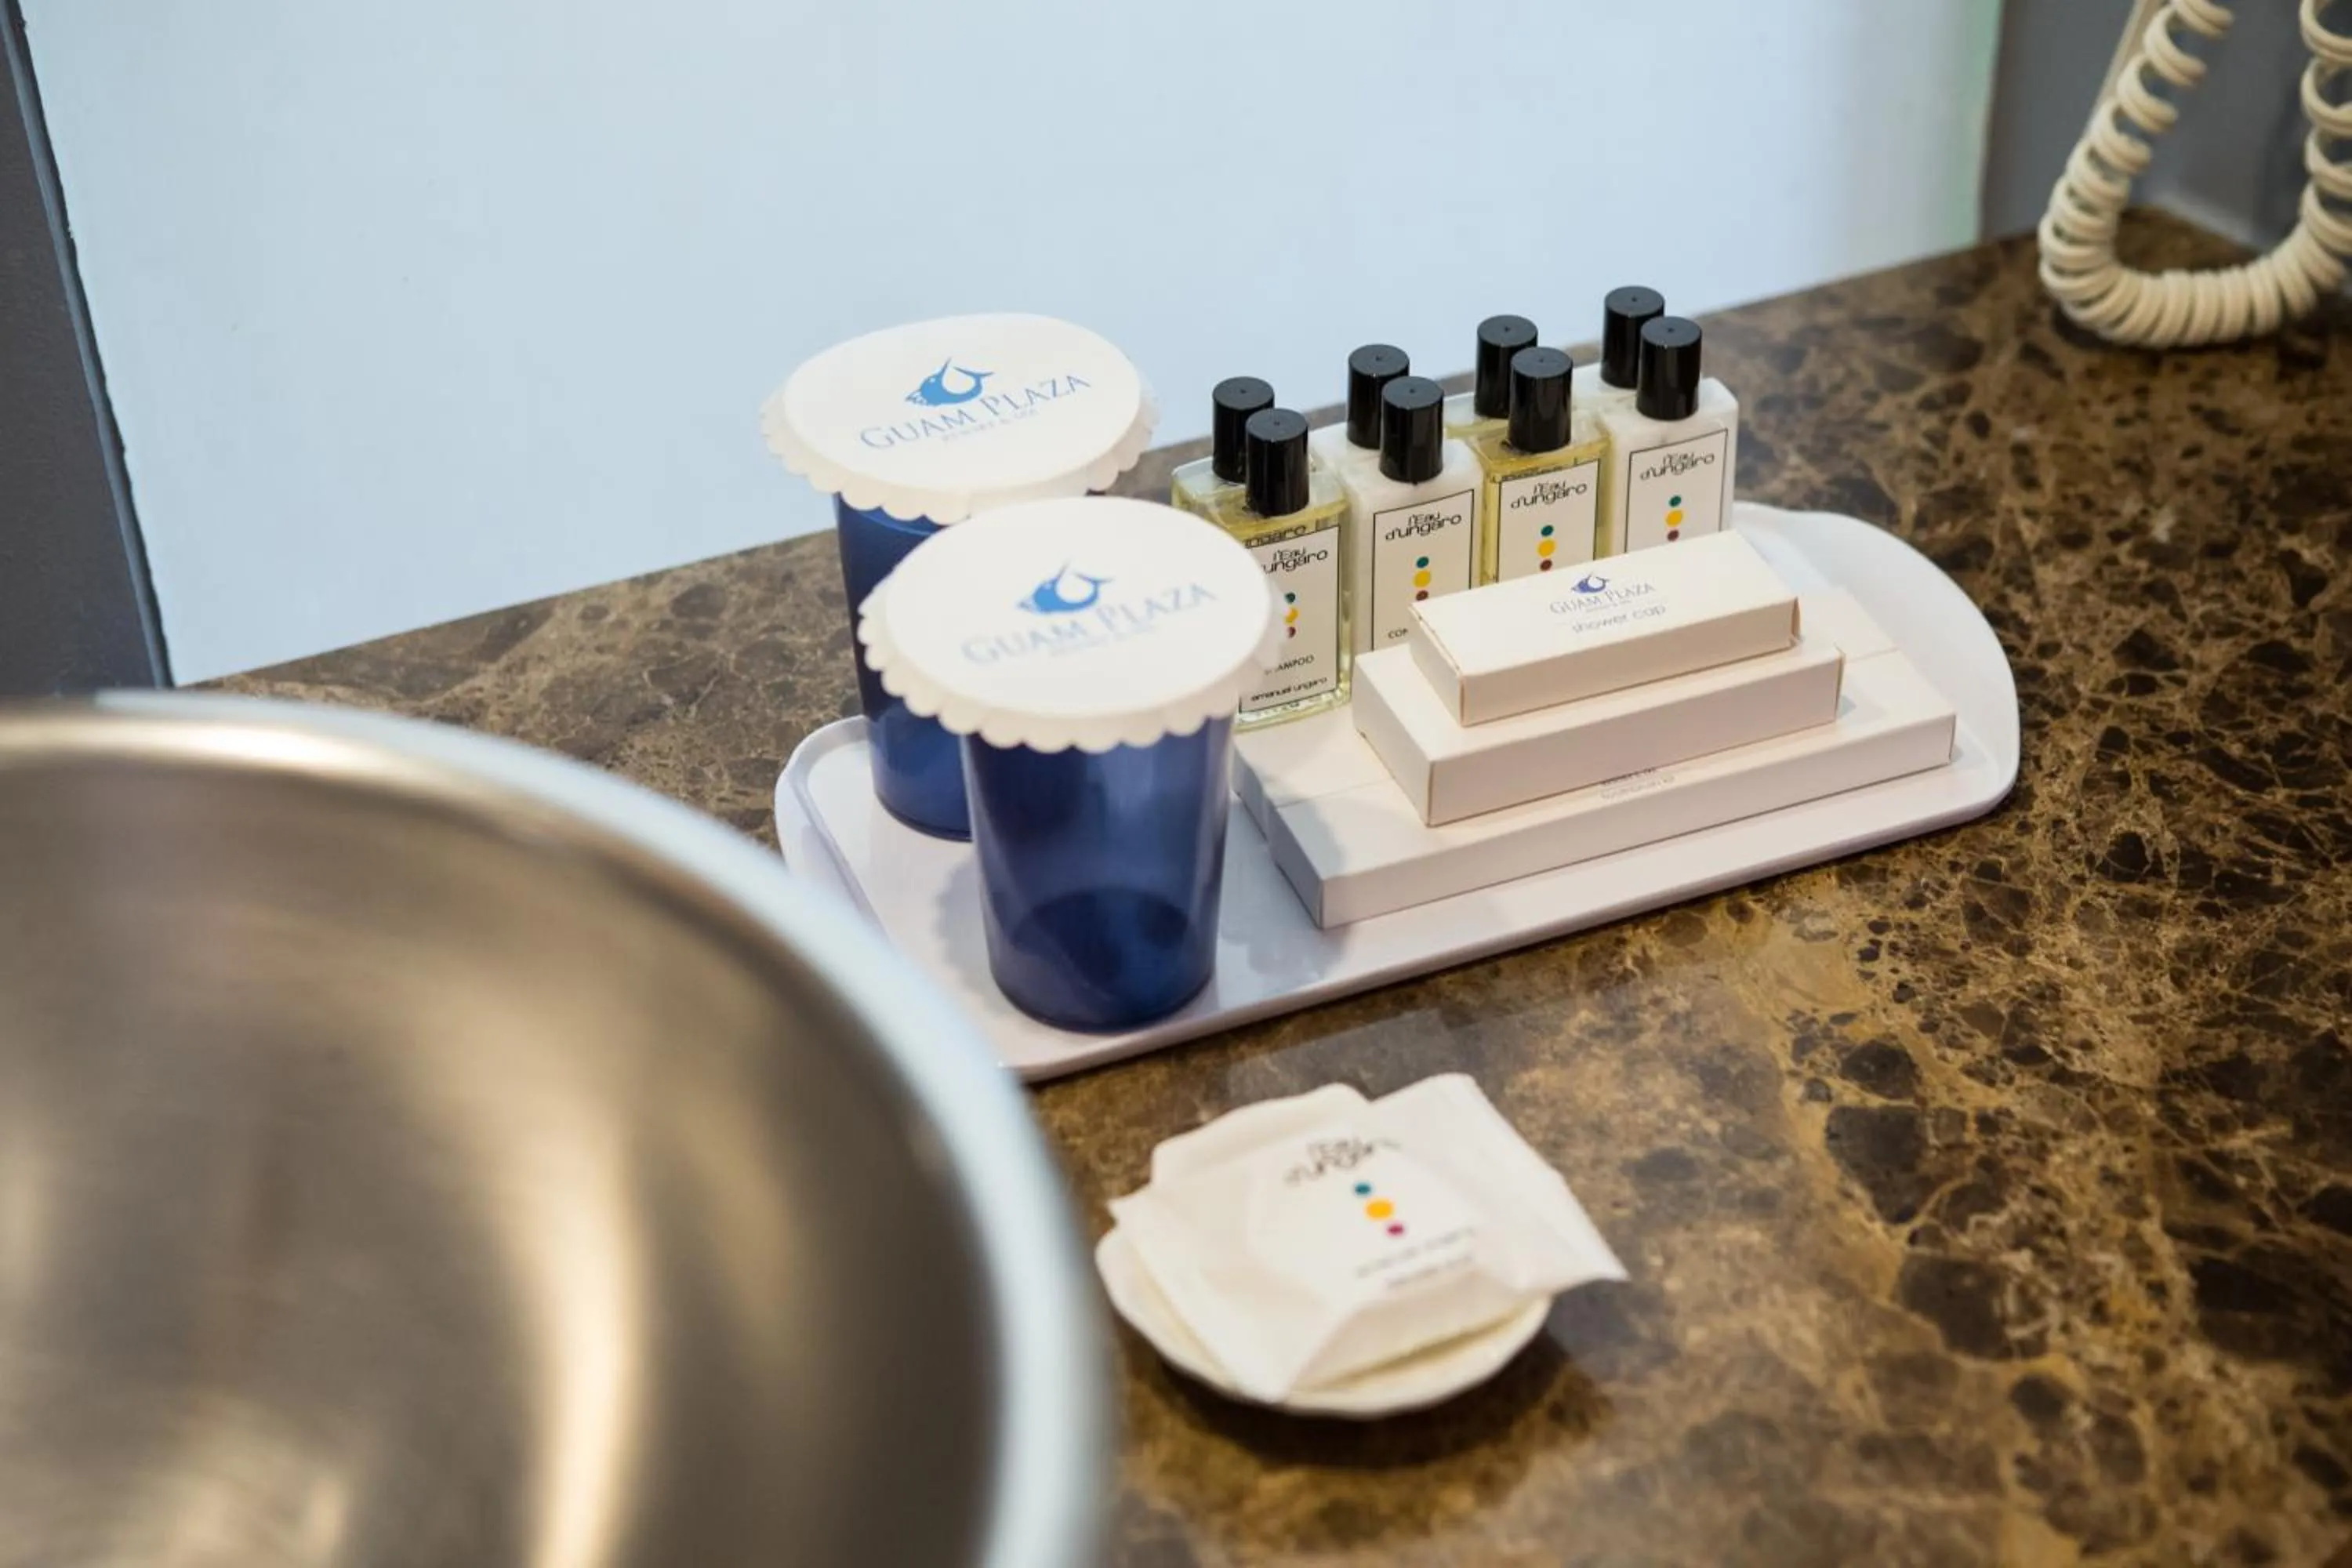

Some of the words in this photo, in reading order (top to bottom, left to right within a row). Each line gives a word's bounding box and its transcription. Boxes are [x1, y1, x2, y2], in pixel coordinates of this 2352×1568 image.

[859, 408, 976, 450] GUAM
[979, 375, 1091, 416] PLAZA
[1261, 550, 1328, 572] ungaro
[960, 619, 1088, 665] GUAM
[1096, 583, 1218, 633] PLAZA
[1632, 604, 1666, 620] cap
